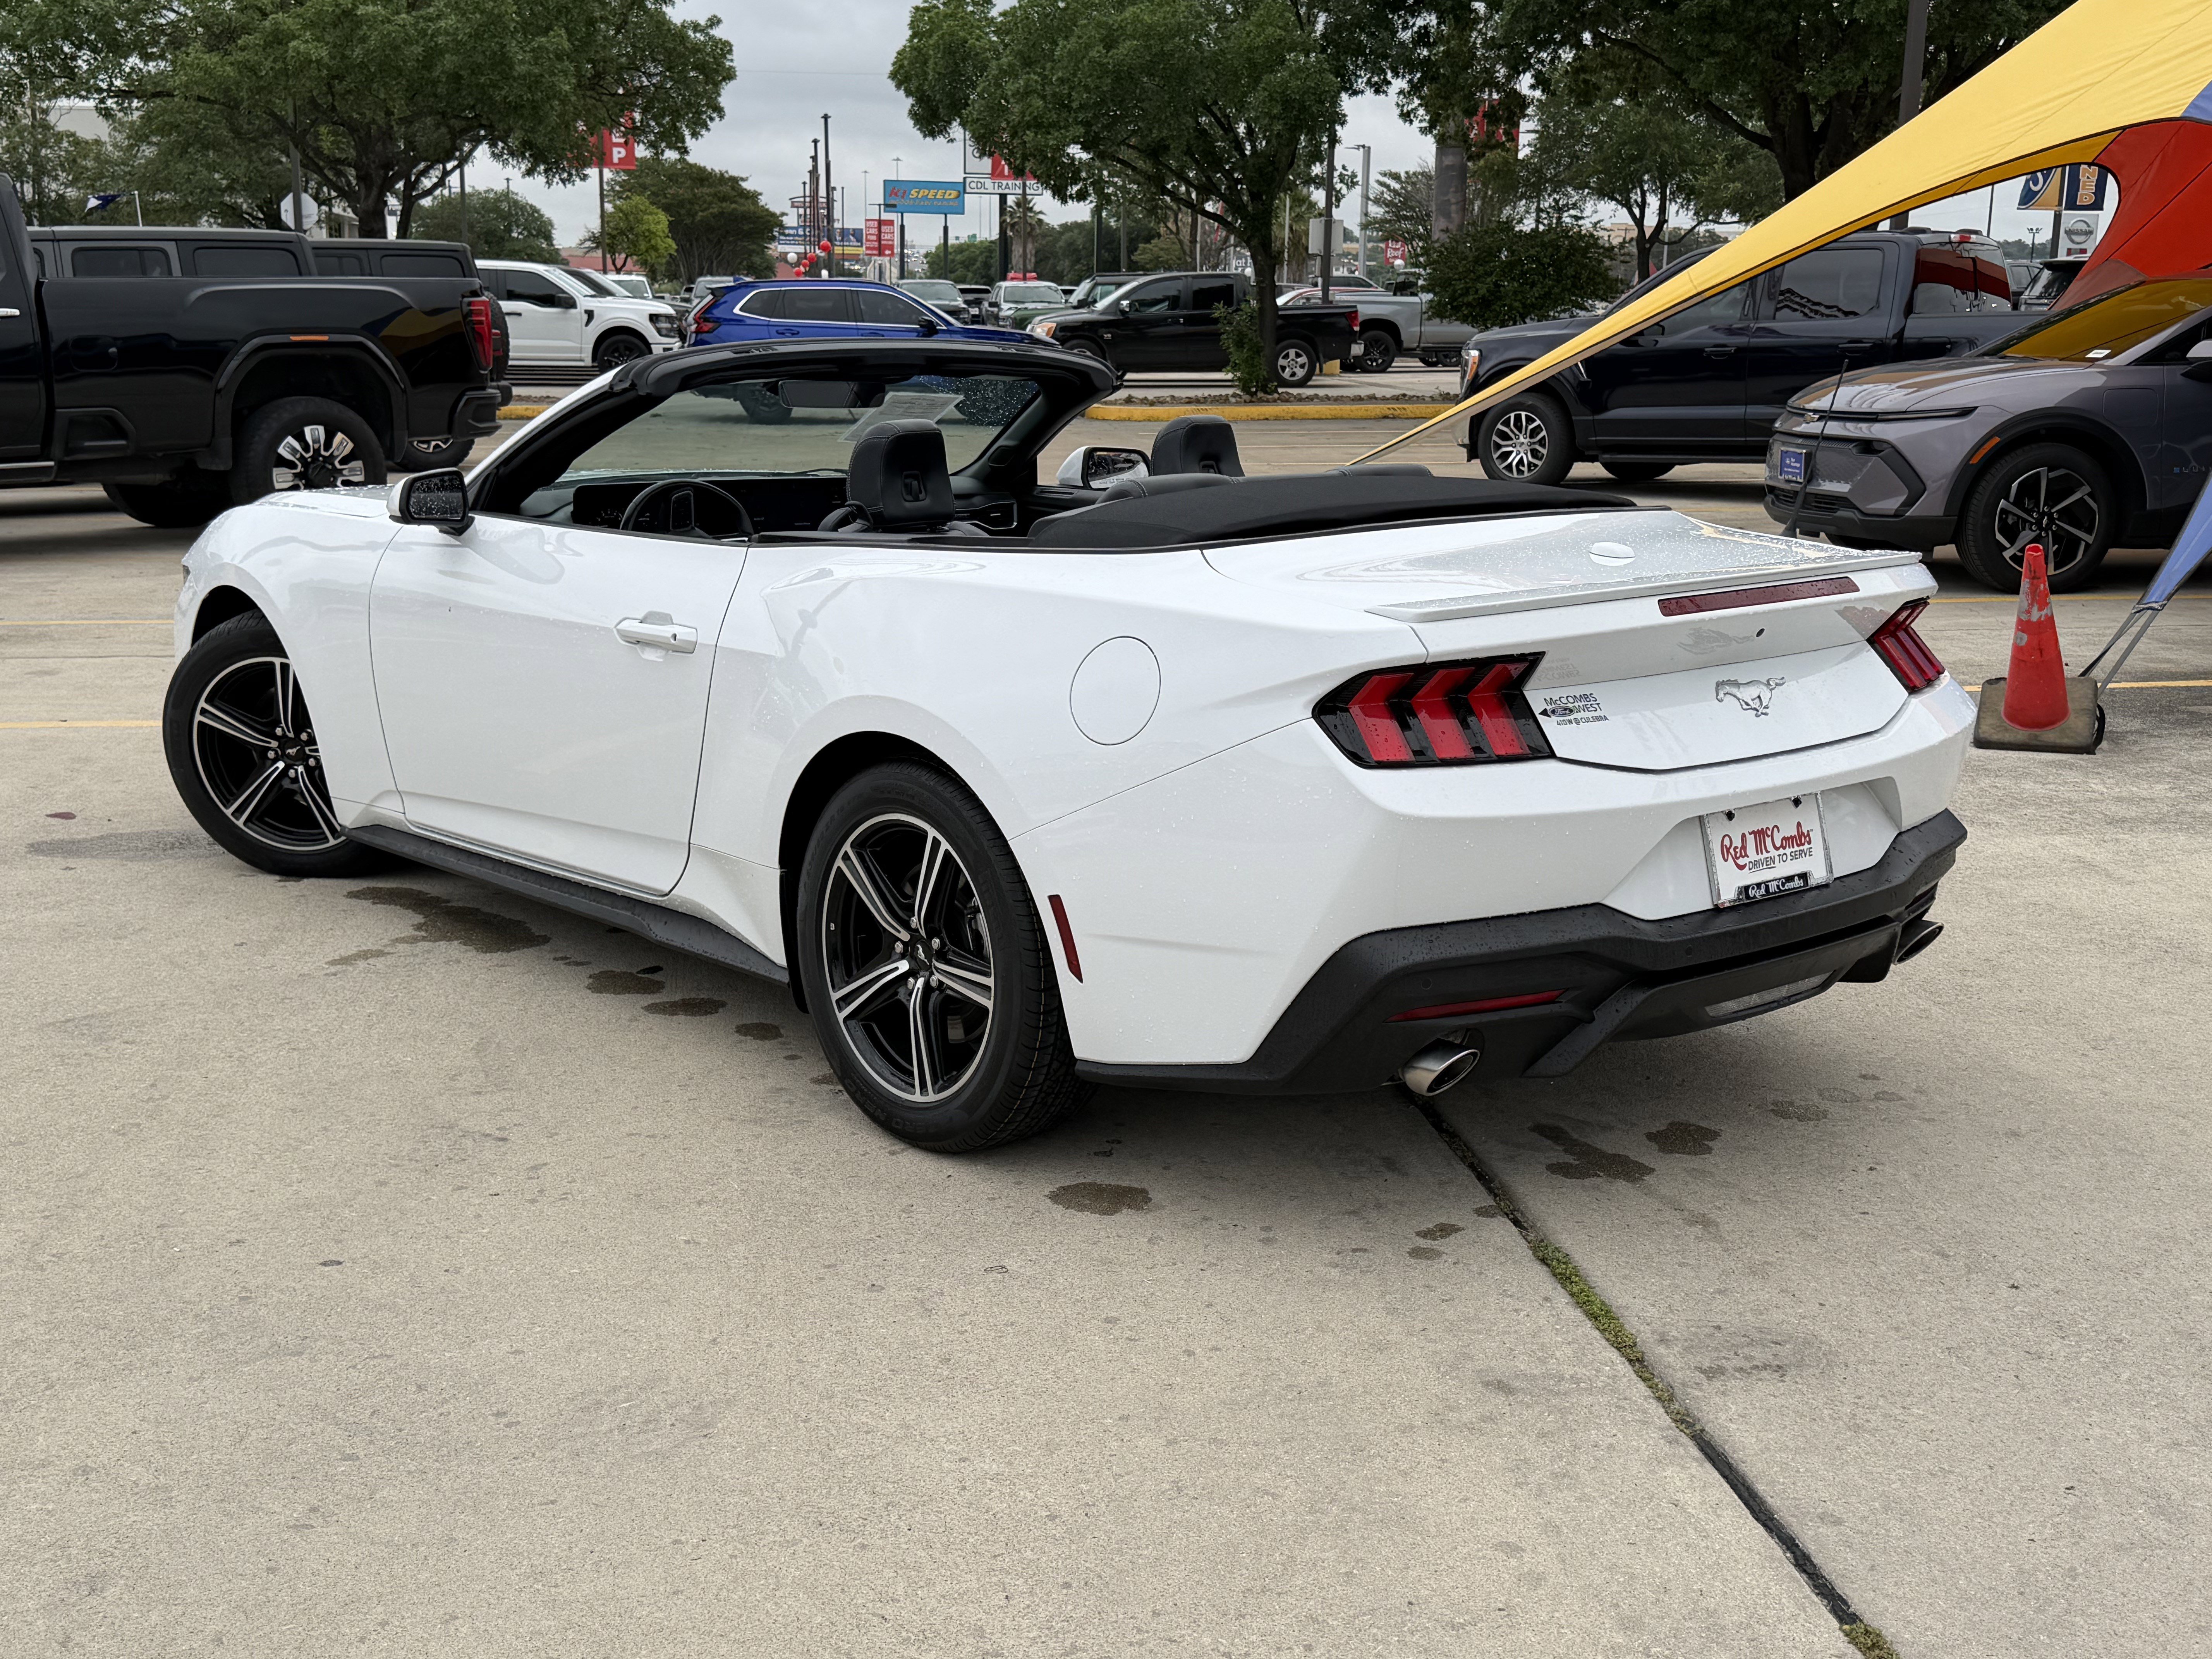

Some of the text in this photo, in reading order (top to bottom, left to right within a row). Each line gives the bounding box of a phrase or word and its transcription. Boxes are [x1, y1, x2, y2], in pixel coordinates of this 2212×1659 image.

[969, 181, 1039, 191] CDL TRAINNG
[909, 189, 960, 199] SPEED
[1544, 693, 1597, 706] McCOMBS
[1575, 703, 1602, 713] WEST
[1721, 833, 1749, 871] Red
[1748, 847, 1813, 871] DRIVEN TO SERVE
[1749, 884, 1766, 898] Red
